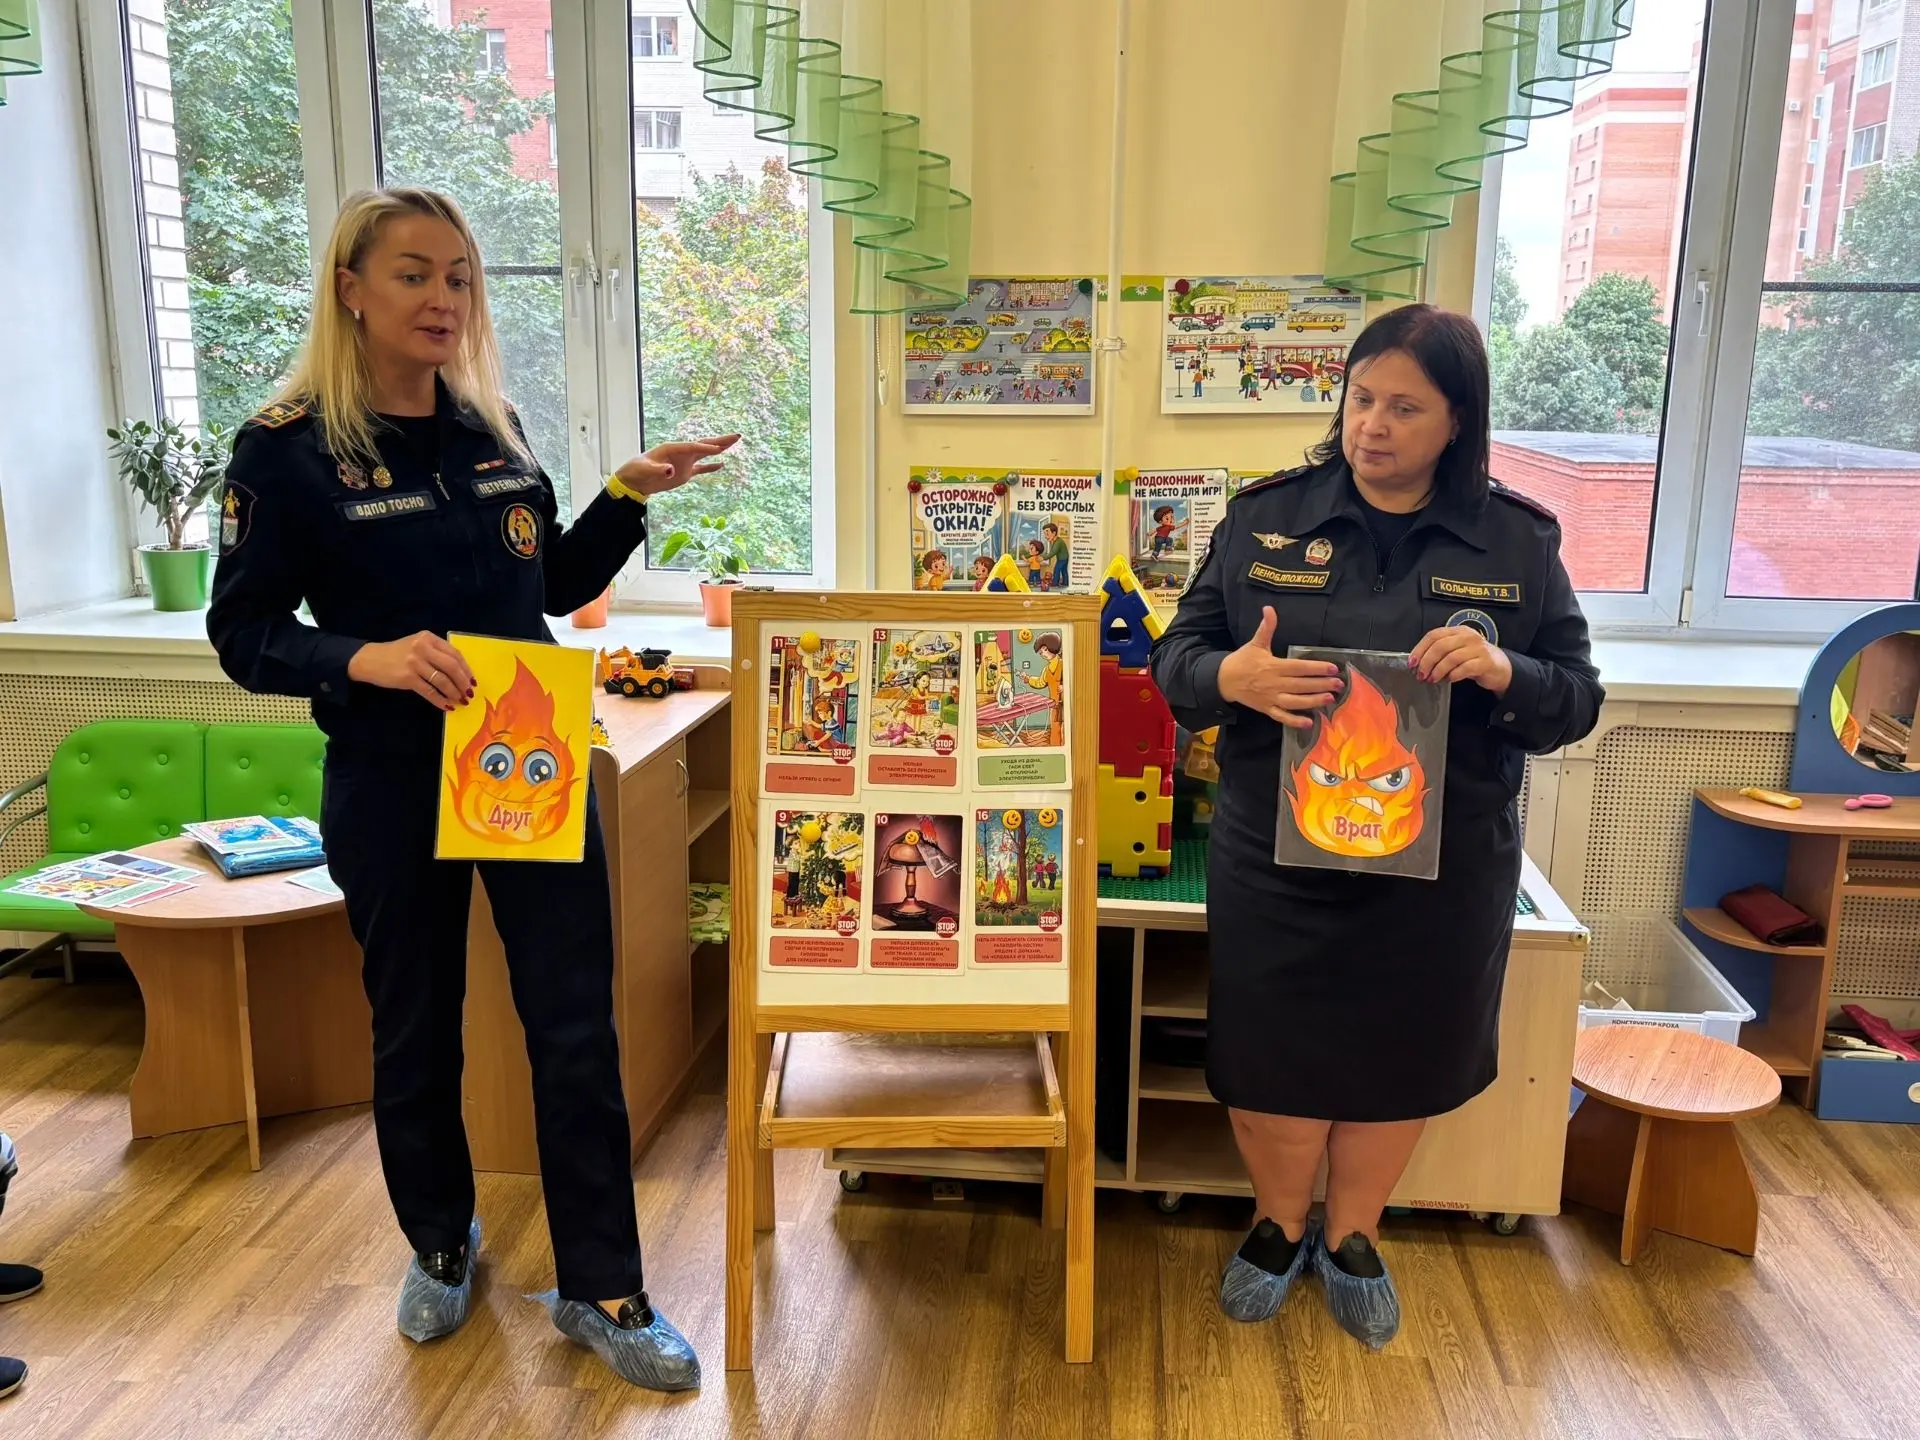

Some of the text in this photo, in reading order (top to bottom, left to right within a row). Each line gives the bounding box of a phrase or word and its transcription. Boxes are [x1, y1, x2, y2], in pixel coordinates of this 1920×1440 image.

[1022, 478, 1092, 490] НЕ ПОДХОДИ
[1135, 475, 1205, 487] ПОДОКОННИК
[921, 489, 997, 505] ОСТОРОЖНО,
[1036, 490, 1080, 501] К ОКНУ
[1135, 486, 1222, 498] НЕ МЕСТО ДЛЯ ИГР!
[355, 496, 425, 517] ВДПО ТОСНО
[924, 502, 993, 518] ОТКРЫТЫЕ
[1017, 500, 1096, 513] БЕЗ ВЗРОСЛЫХ
[933, 515, 986, 532] ОКНА!
[1253, 566, 1325, 584] ЛЕНОБЛПОЖСПАС
[1440, 582, 1510, 597] КОЛЫЧЕВА Т.В.
[1467, 612, 1481, 620] ГКУ
[875, 630, 886, 640] 13
[978, 632, 984, 642] 1
[774, 638, 784, 648] 11
[935, 740, 954, 748] STOP
[833, 748, 852, 756] STOP
[488, 804, 533, 831] Друг
[779, 812, 787, 821] 9
[876, 815, 888, 824] 10
[976, 811, 989, 820] 16
[1334, 815, 1382, 841] Враг
[837, 921, 856, 929] STOP
[1040, 916, 1058, 924] STOP
[937, 922, 955, 931] STOP
